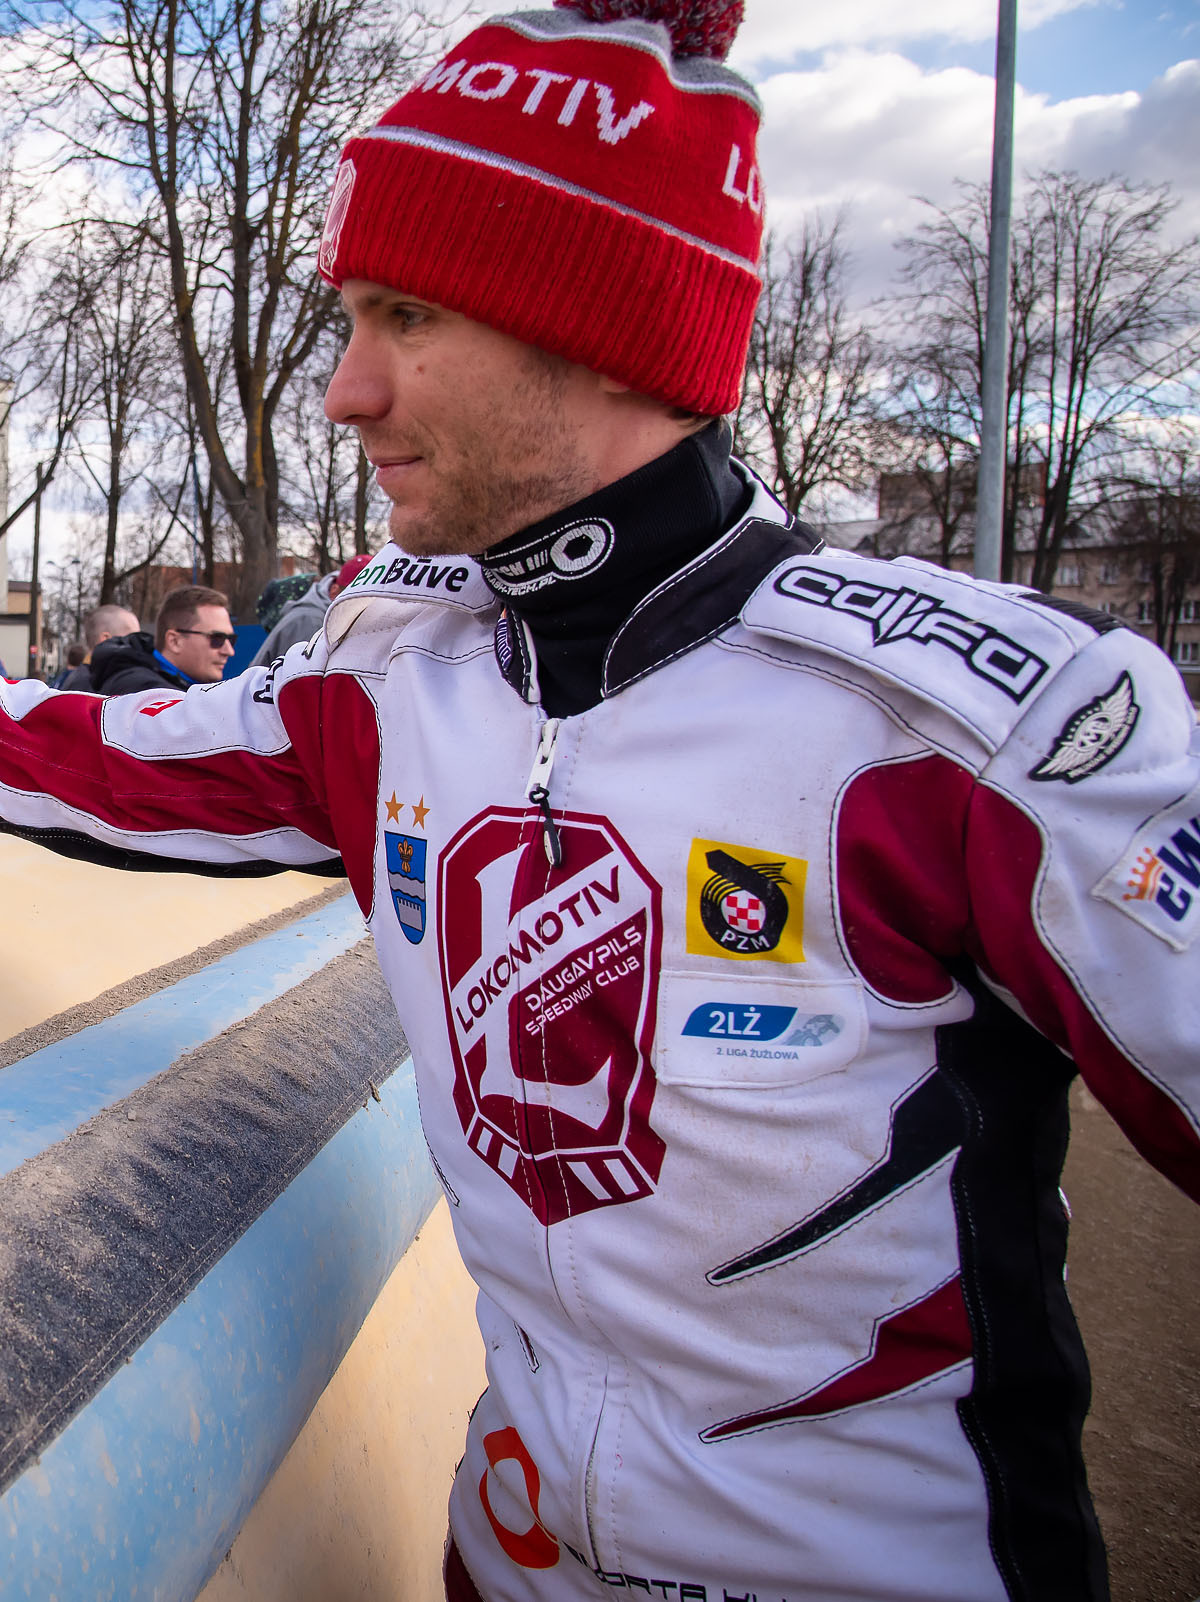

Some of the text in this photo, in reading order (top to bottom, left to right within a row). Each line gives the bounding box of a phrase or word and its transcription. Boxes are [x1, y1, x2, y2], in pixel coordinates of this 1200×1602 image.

[456, 865, 620, 1034] LOKOMOTIV
[720, 929, 771, 950] PZM
[525, 925, 642, 1012] DAUGAVPILS
[525, 955, 641, 1036] SPEEDWAY CLUB
[708, 1006, 762, 1036] 2LŻ
[726, 1048, 748, 1058] LIGA
